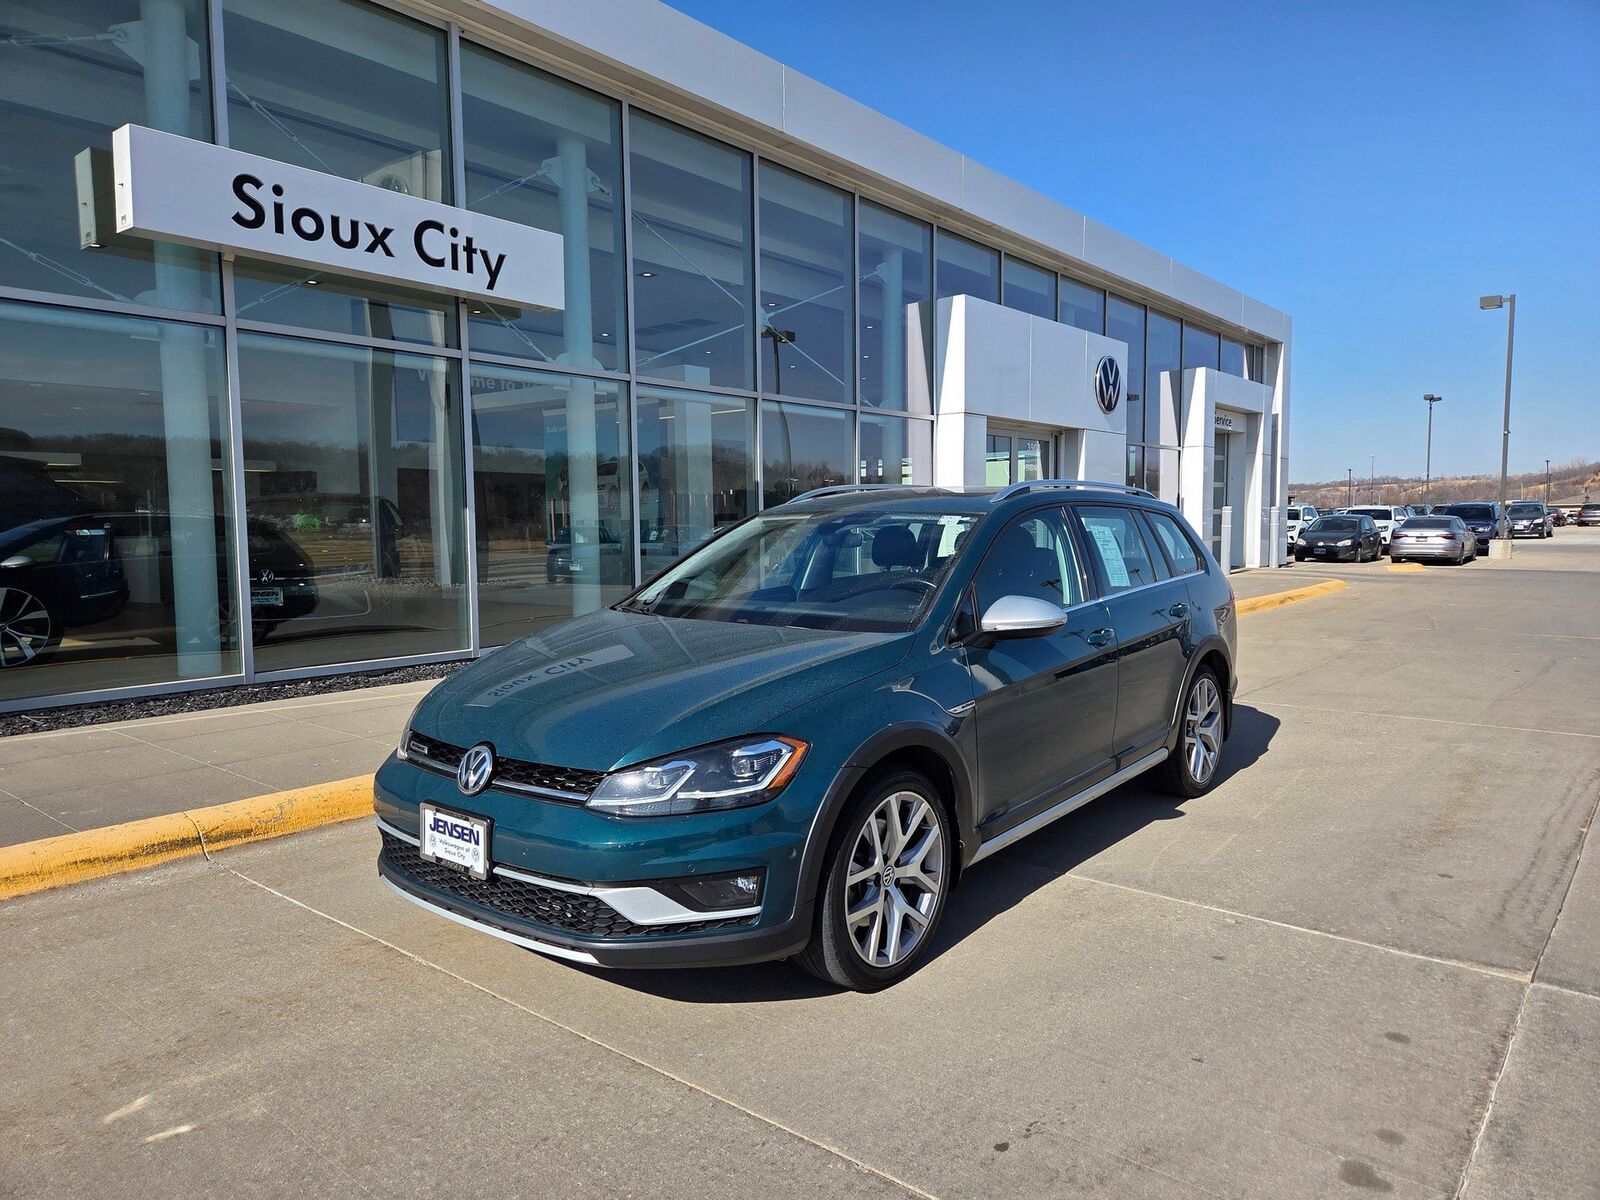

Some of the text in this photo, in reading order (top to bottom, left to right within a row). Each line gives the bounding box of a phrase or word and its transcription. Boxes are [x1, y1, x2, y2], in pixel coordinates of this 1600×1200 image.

[231, 173, 507, 291] Sioux City
[429, 817, 480, 847] JENSEN
[439, 838, 465, 851] Volkswagen
[444, 847, 465, 861] Sioux City
